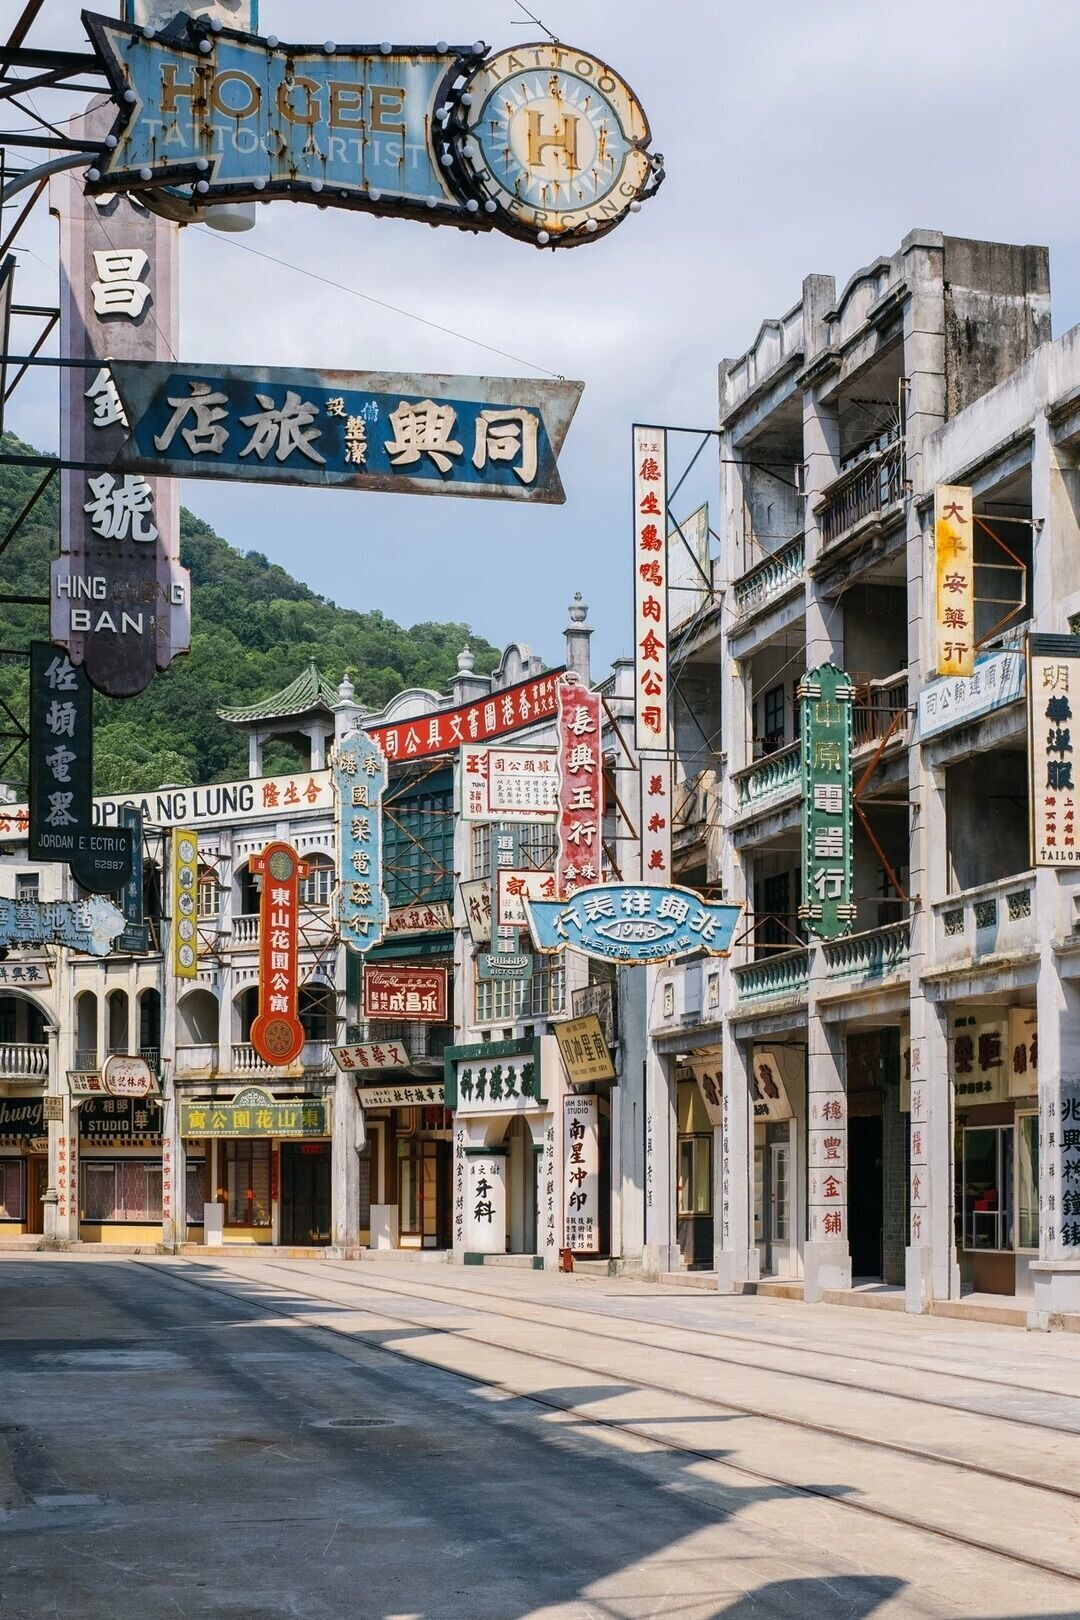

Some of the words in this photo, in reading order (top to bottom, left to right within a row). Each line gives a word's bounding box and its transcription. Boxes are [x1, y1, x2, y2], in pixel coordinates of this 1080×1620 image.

[485, 48, 617, 94] TATTOO
[275, 74, 406, 134] GEE
[141, 117, 287, 157] TATTOO
[301, 134, 428, 171] ARTIST
[524, 107, 581, 171] H
[57, 575, 107, 600] HING
[44, 656, 79, 827] 佐頓電器
[193, 784, 254, 817] LUNG
[38, 834, 74, 849] JORDAN
[94, 860, 124, 870] 62987
[616, 924, 657, 938] 1945
[269, 887, 291, 1014] 東山花園公寓
[567, 1107, 589, 1115] STUDIO
[577, 1099, 593, 1107] SING
[88, 1120, 129, 1131] STUDIO
[188, 1109, 320, 1130] 東山花園公寓
[474, 1177, 497, 1224] 牙科
